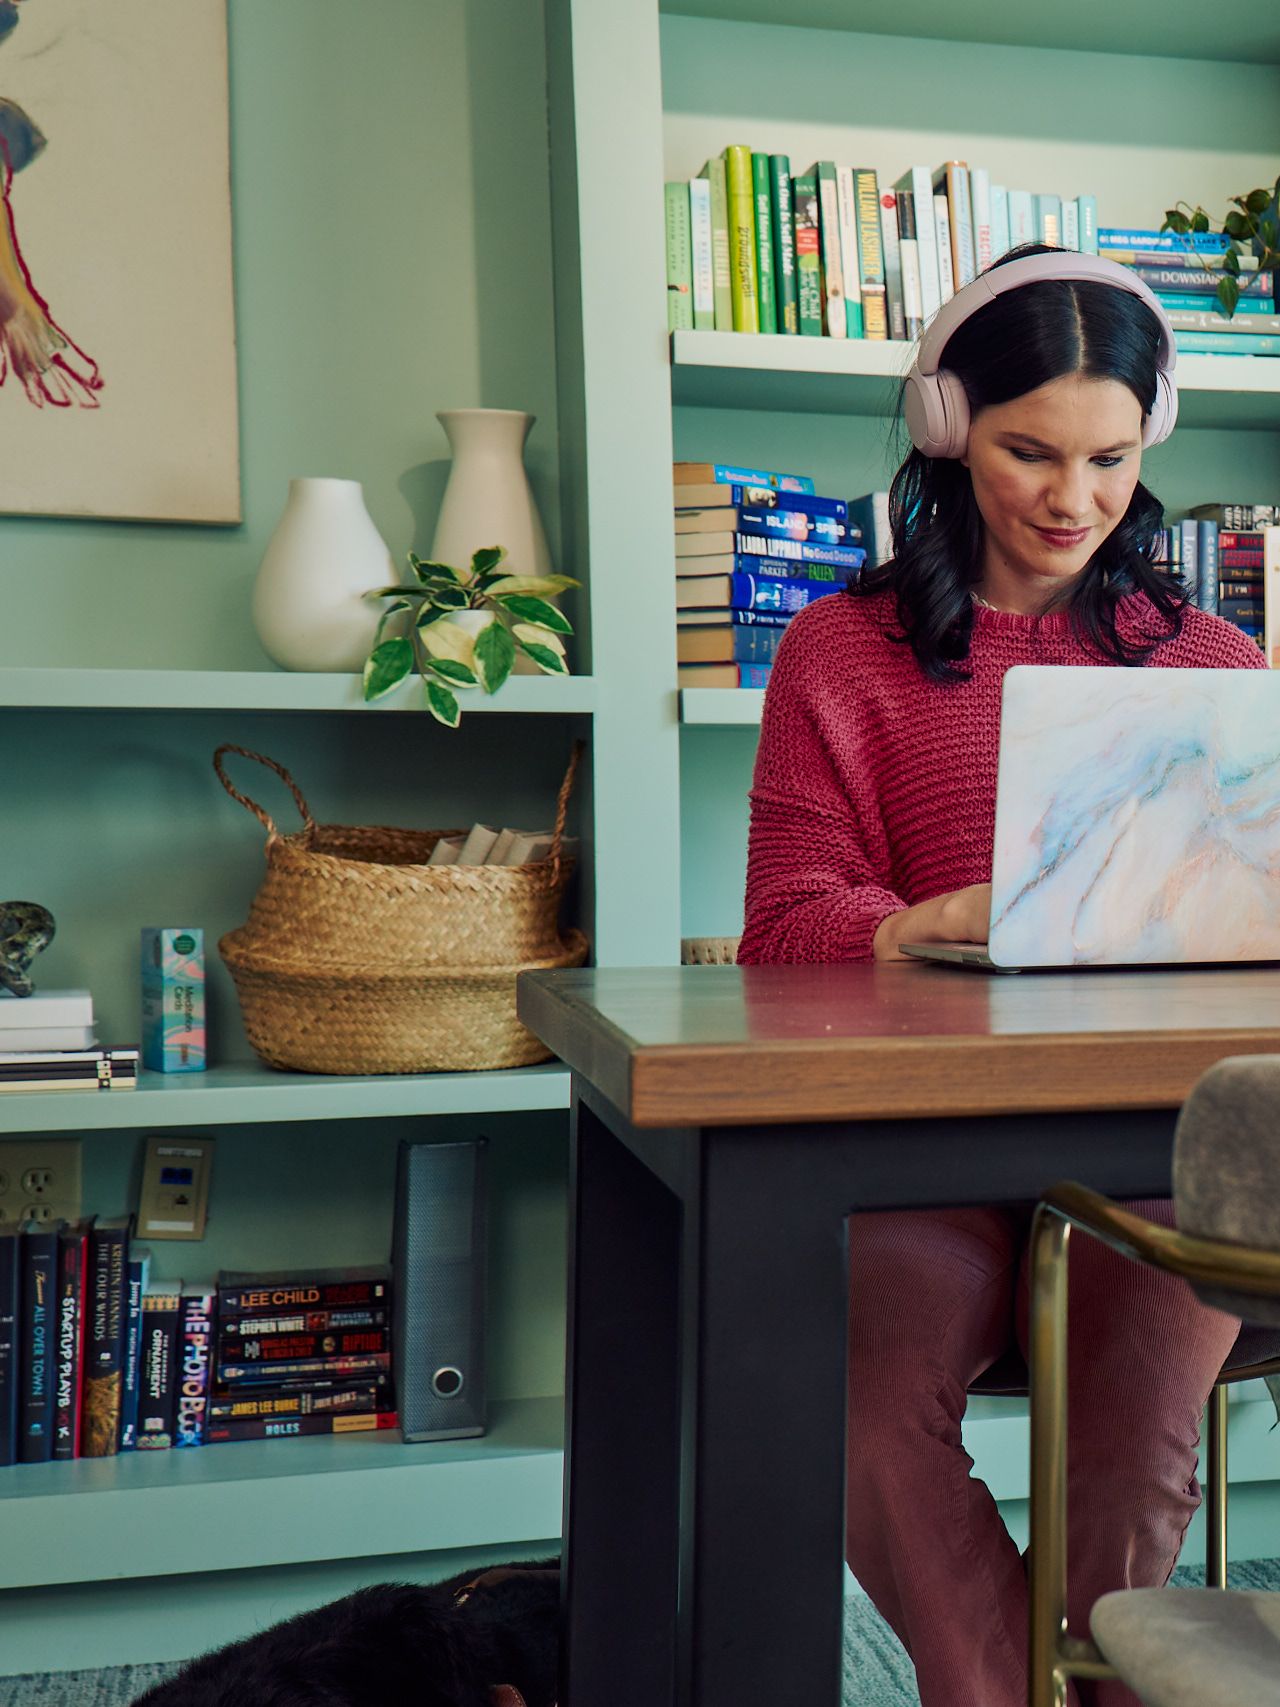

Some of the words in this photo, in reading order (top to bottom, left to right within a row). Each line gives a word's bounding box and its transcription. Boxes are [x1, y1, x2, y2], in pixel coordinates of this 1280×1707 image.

[857, 173, 878, 223] WILLIAM
[860, 224, 882, 276] LASHNER
[758, 565, 788, 578] PARKER
[184, 986, 194, 1033] Meditation
[129, 1280, 141, 1307] Jump
[240, 1292, 270, 1308] LEE
[272, 1289, 321, 1305] CHILD
[33, 1305, 46, 1323] ALL
[59, 1296, 76, 1361] STARTUP
[184, 1296, 212, 1333] THE
[33, 1326, 46, 1356] OVER
[31, 1358, 45, 1397] TOWN
[149, 1328, 163, 1399] ORNAMENT
[181, 1333, 209, 1397] PHOTO
